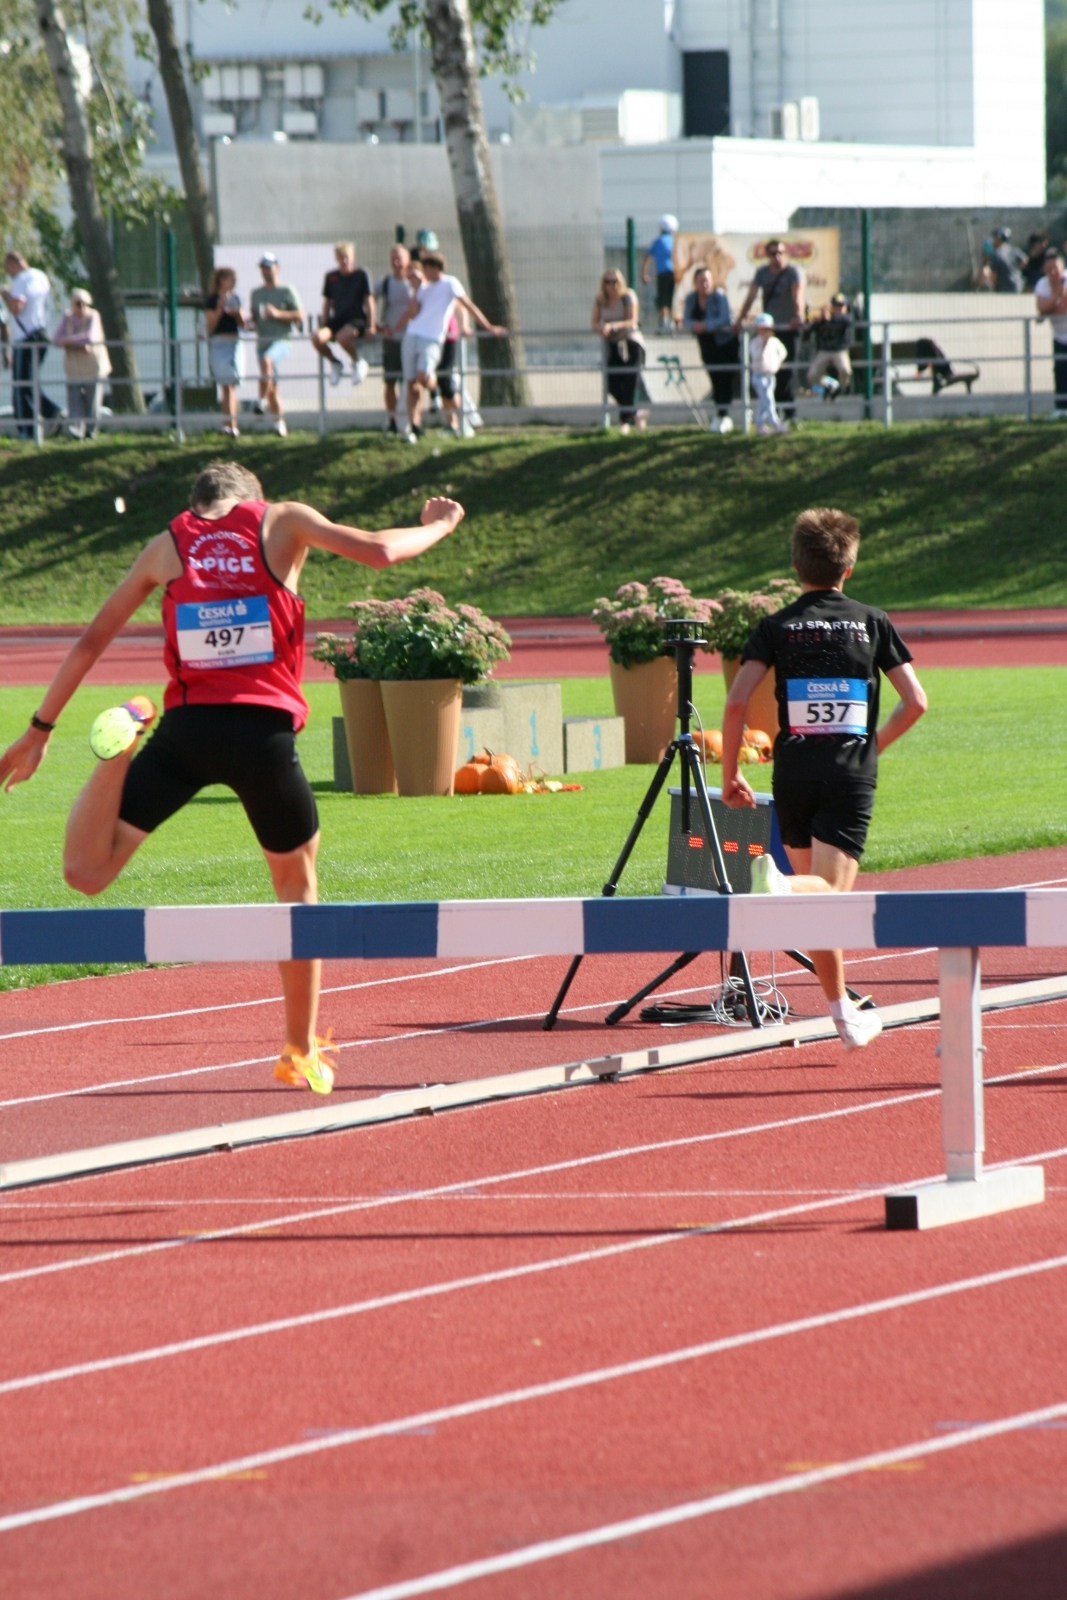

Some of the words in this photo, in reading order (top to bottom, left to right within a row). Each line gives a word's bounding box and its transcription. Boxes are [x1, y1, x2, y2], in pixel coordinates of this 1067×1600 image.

[198, 603, 234, 620] ČESKÁ
[789, 622, 803, 631] TJ
[806, 620, 867, 631] SPARTAK
[204, 627, 245, 648] 497
[807, 681, 838, 693] ČESKÁ
[806, 702, 850, 723] 537
[530, 709, 538, 756] 1
[593, 724, 601, 769] 3
